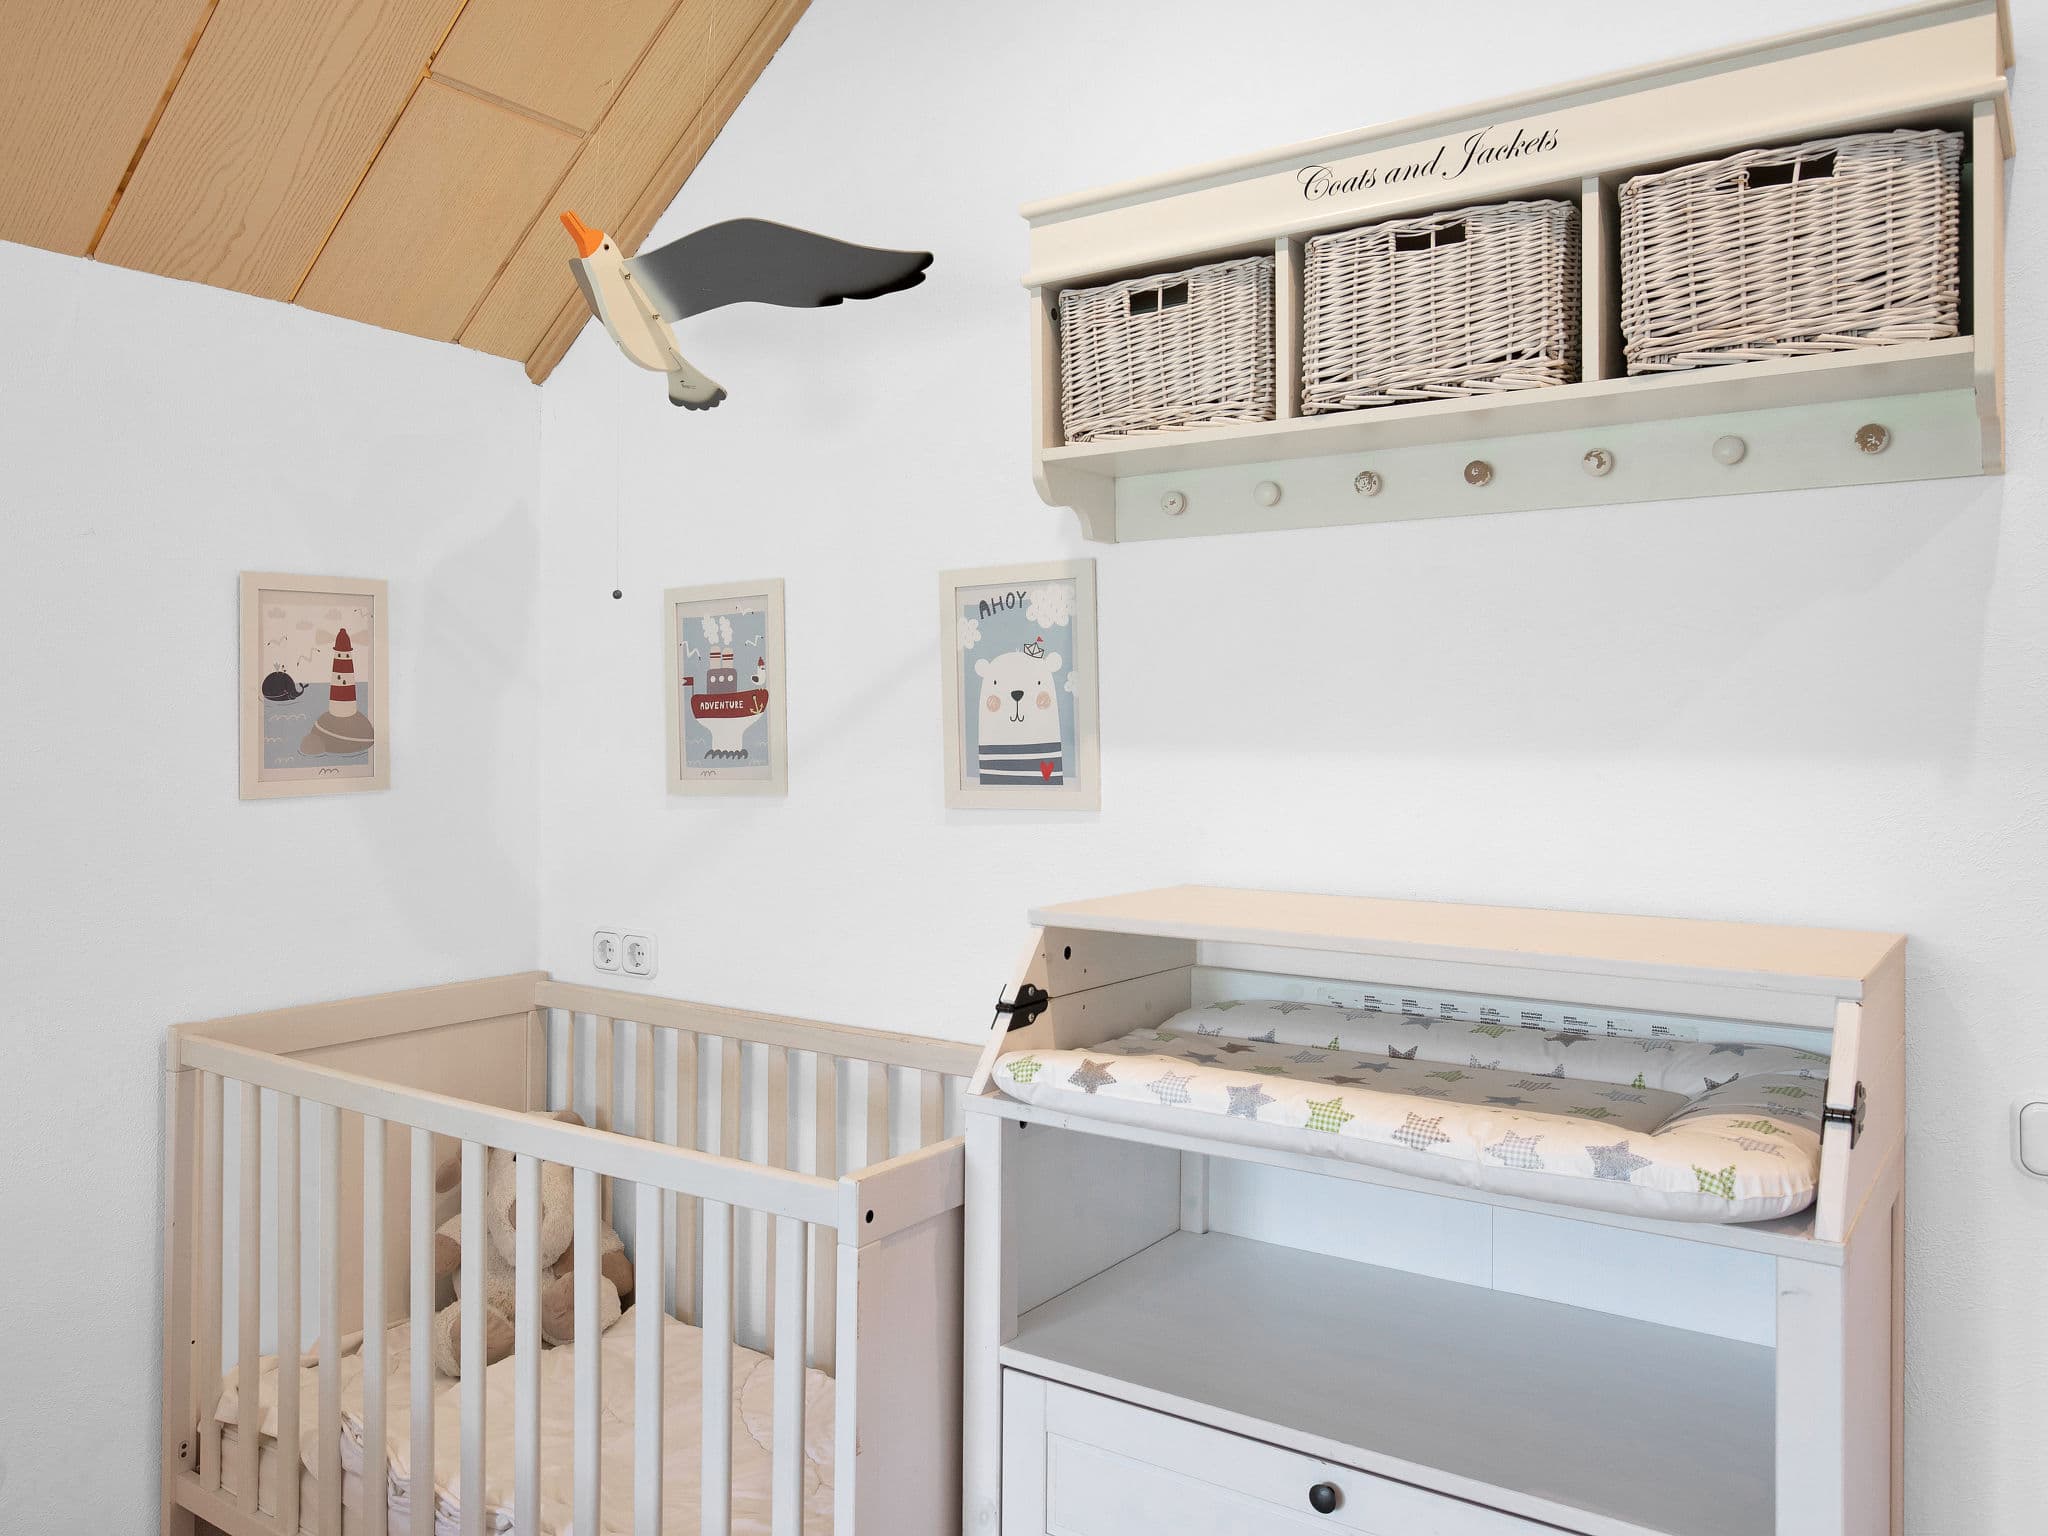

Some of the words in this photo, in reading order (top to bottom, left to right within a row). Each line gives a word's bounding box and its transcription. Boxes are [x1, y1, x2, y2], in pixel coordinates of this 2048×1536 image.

[1296, 165, 1377, 201] Coats
[1384, 145, 1446, 183] and
[1442, 125, 1559, 181] Jackets
[978, 590, 1027, 620] AHOY
[699, 700, 744, 711] ADVENTURE
